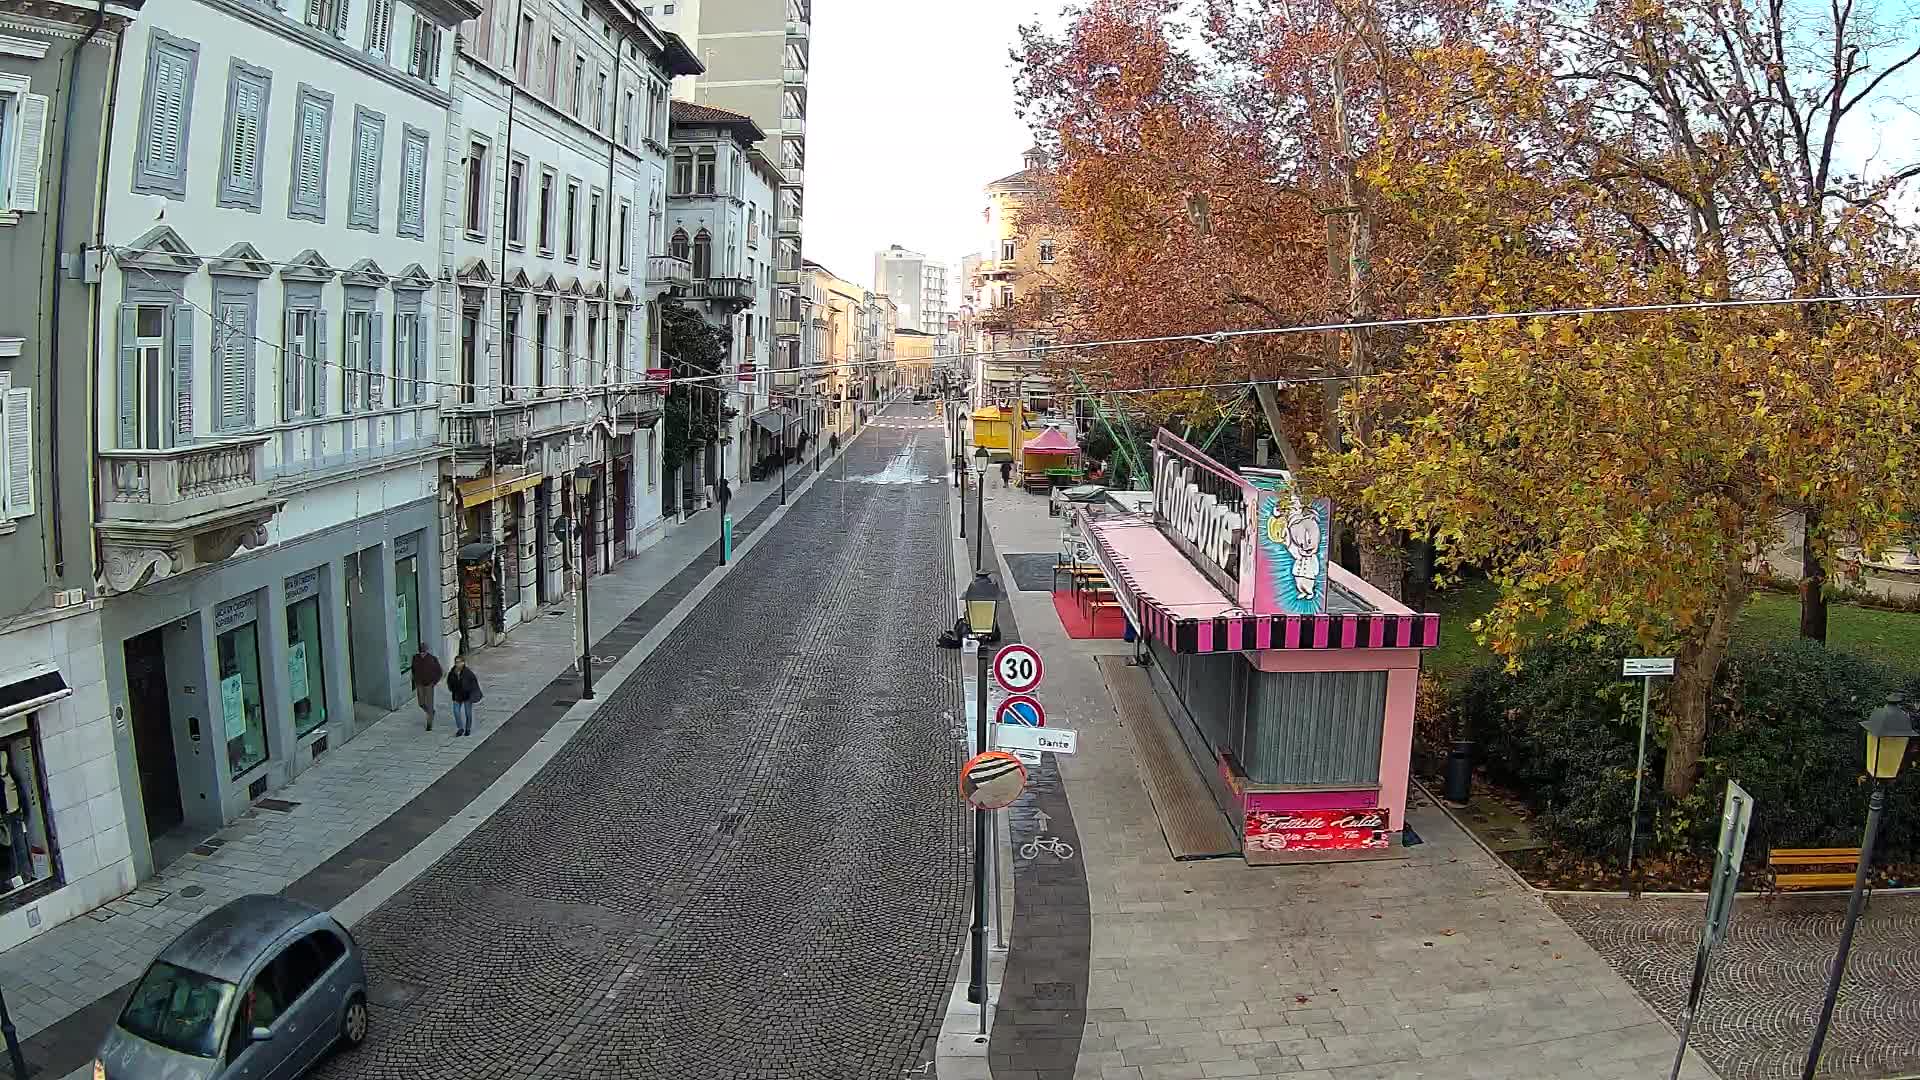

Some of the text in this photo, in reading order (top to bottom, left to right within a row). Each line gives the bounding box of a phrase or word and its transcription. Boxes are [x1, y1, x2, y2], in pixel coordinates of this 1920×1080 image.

[1005, 658, 1033, 680] 30
[1038, 737, 1069, 748] Dante
[1330, 815, 1383, 828] Calde
